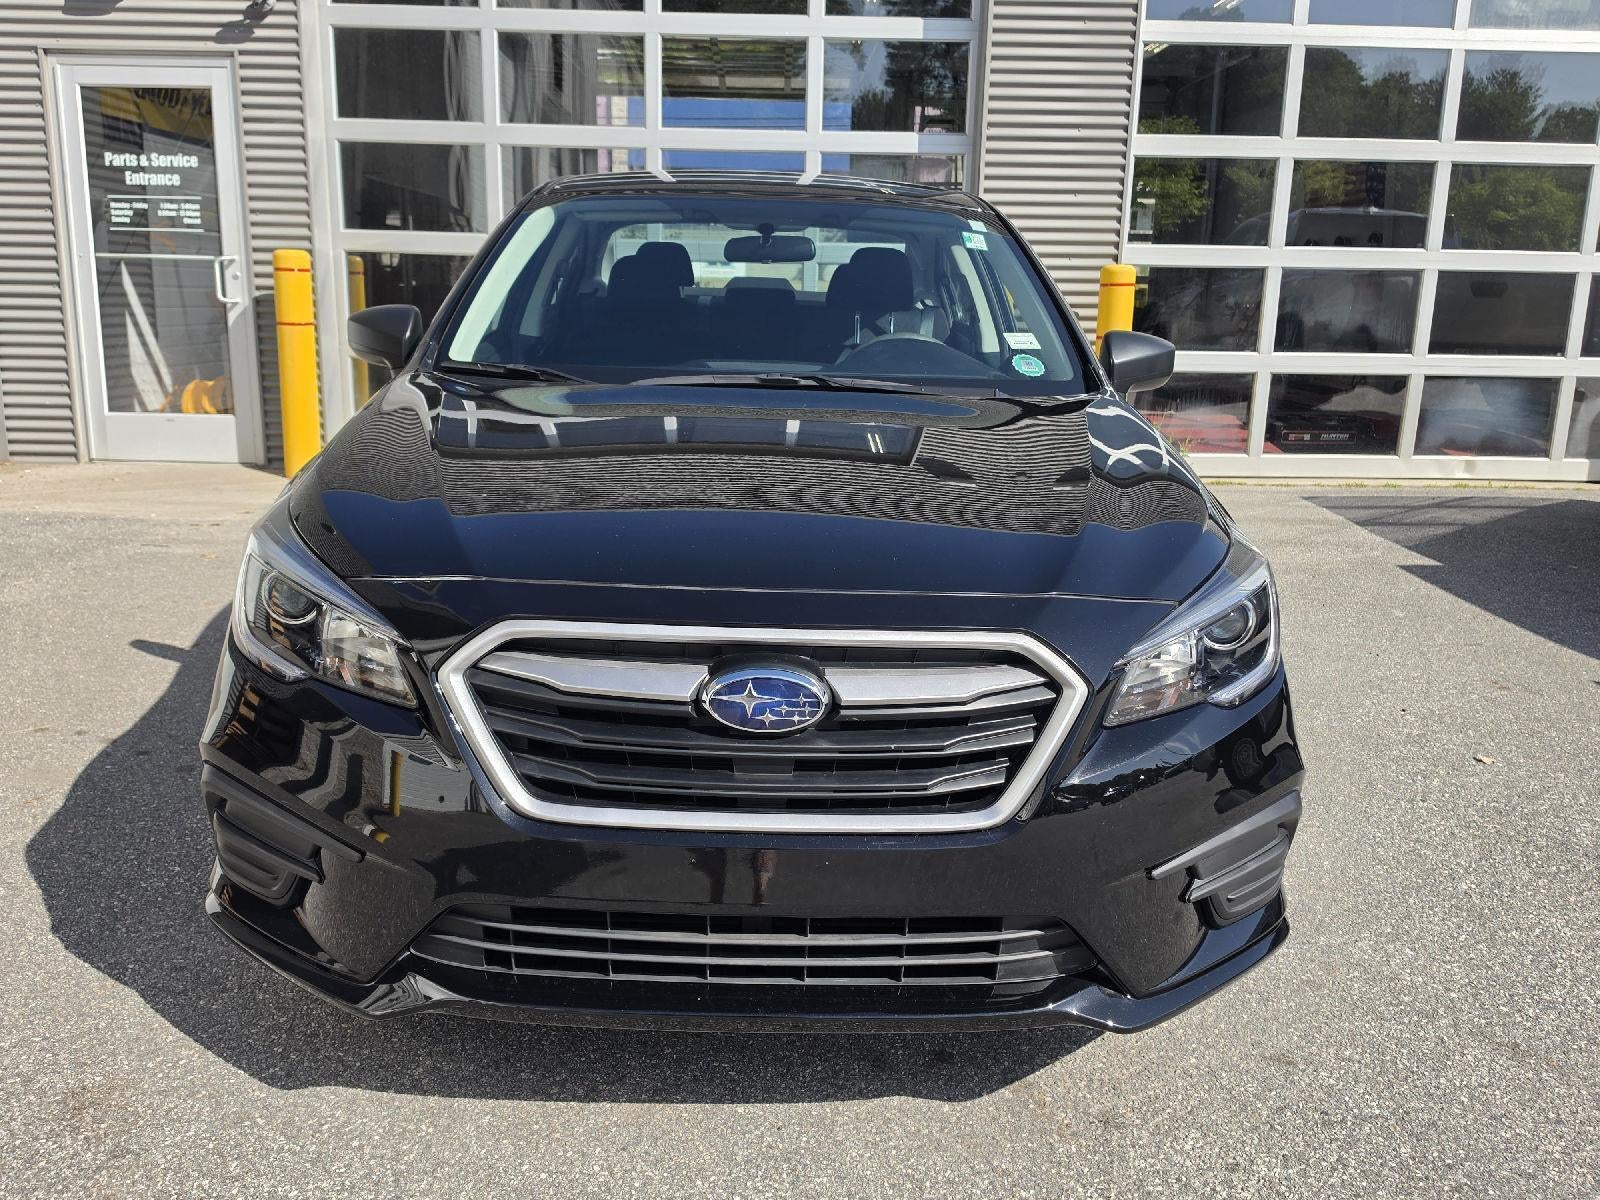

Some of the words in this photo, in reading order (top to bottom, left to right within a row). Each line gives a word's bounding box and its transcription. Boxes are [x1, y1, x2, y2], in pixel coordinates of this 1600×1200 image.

[104, 151, 138, 167] Parts
[140, 154, 149, 167] &
[150, 152, 198, 167] Service
[125, 171, 180, 186] Entrance
